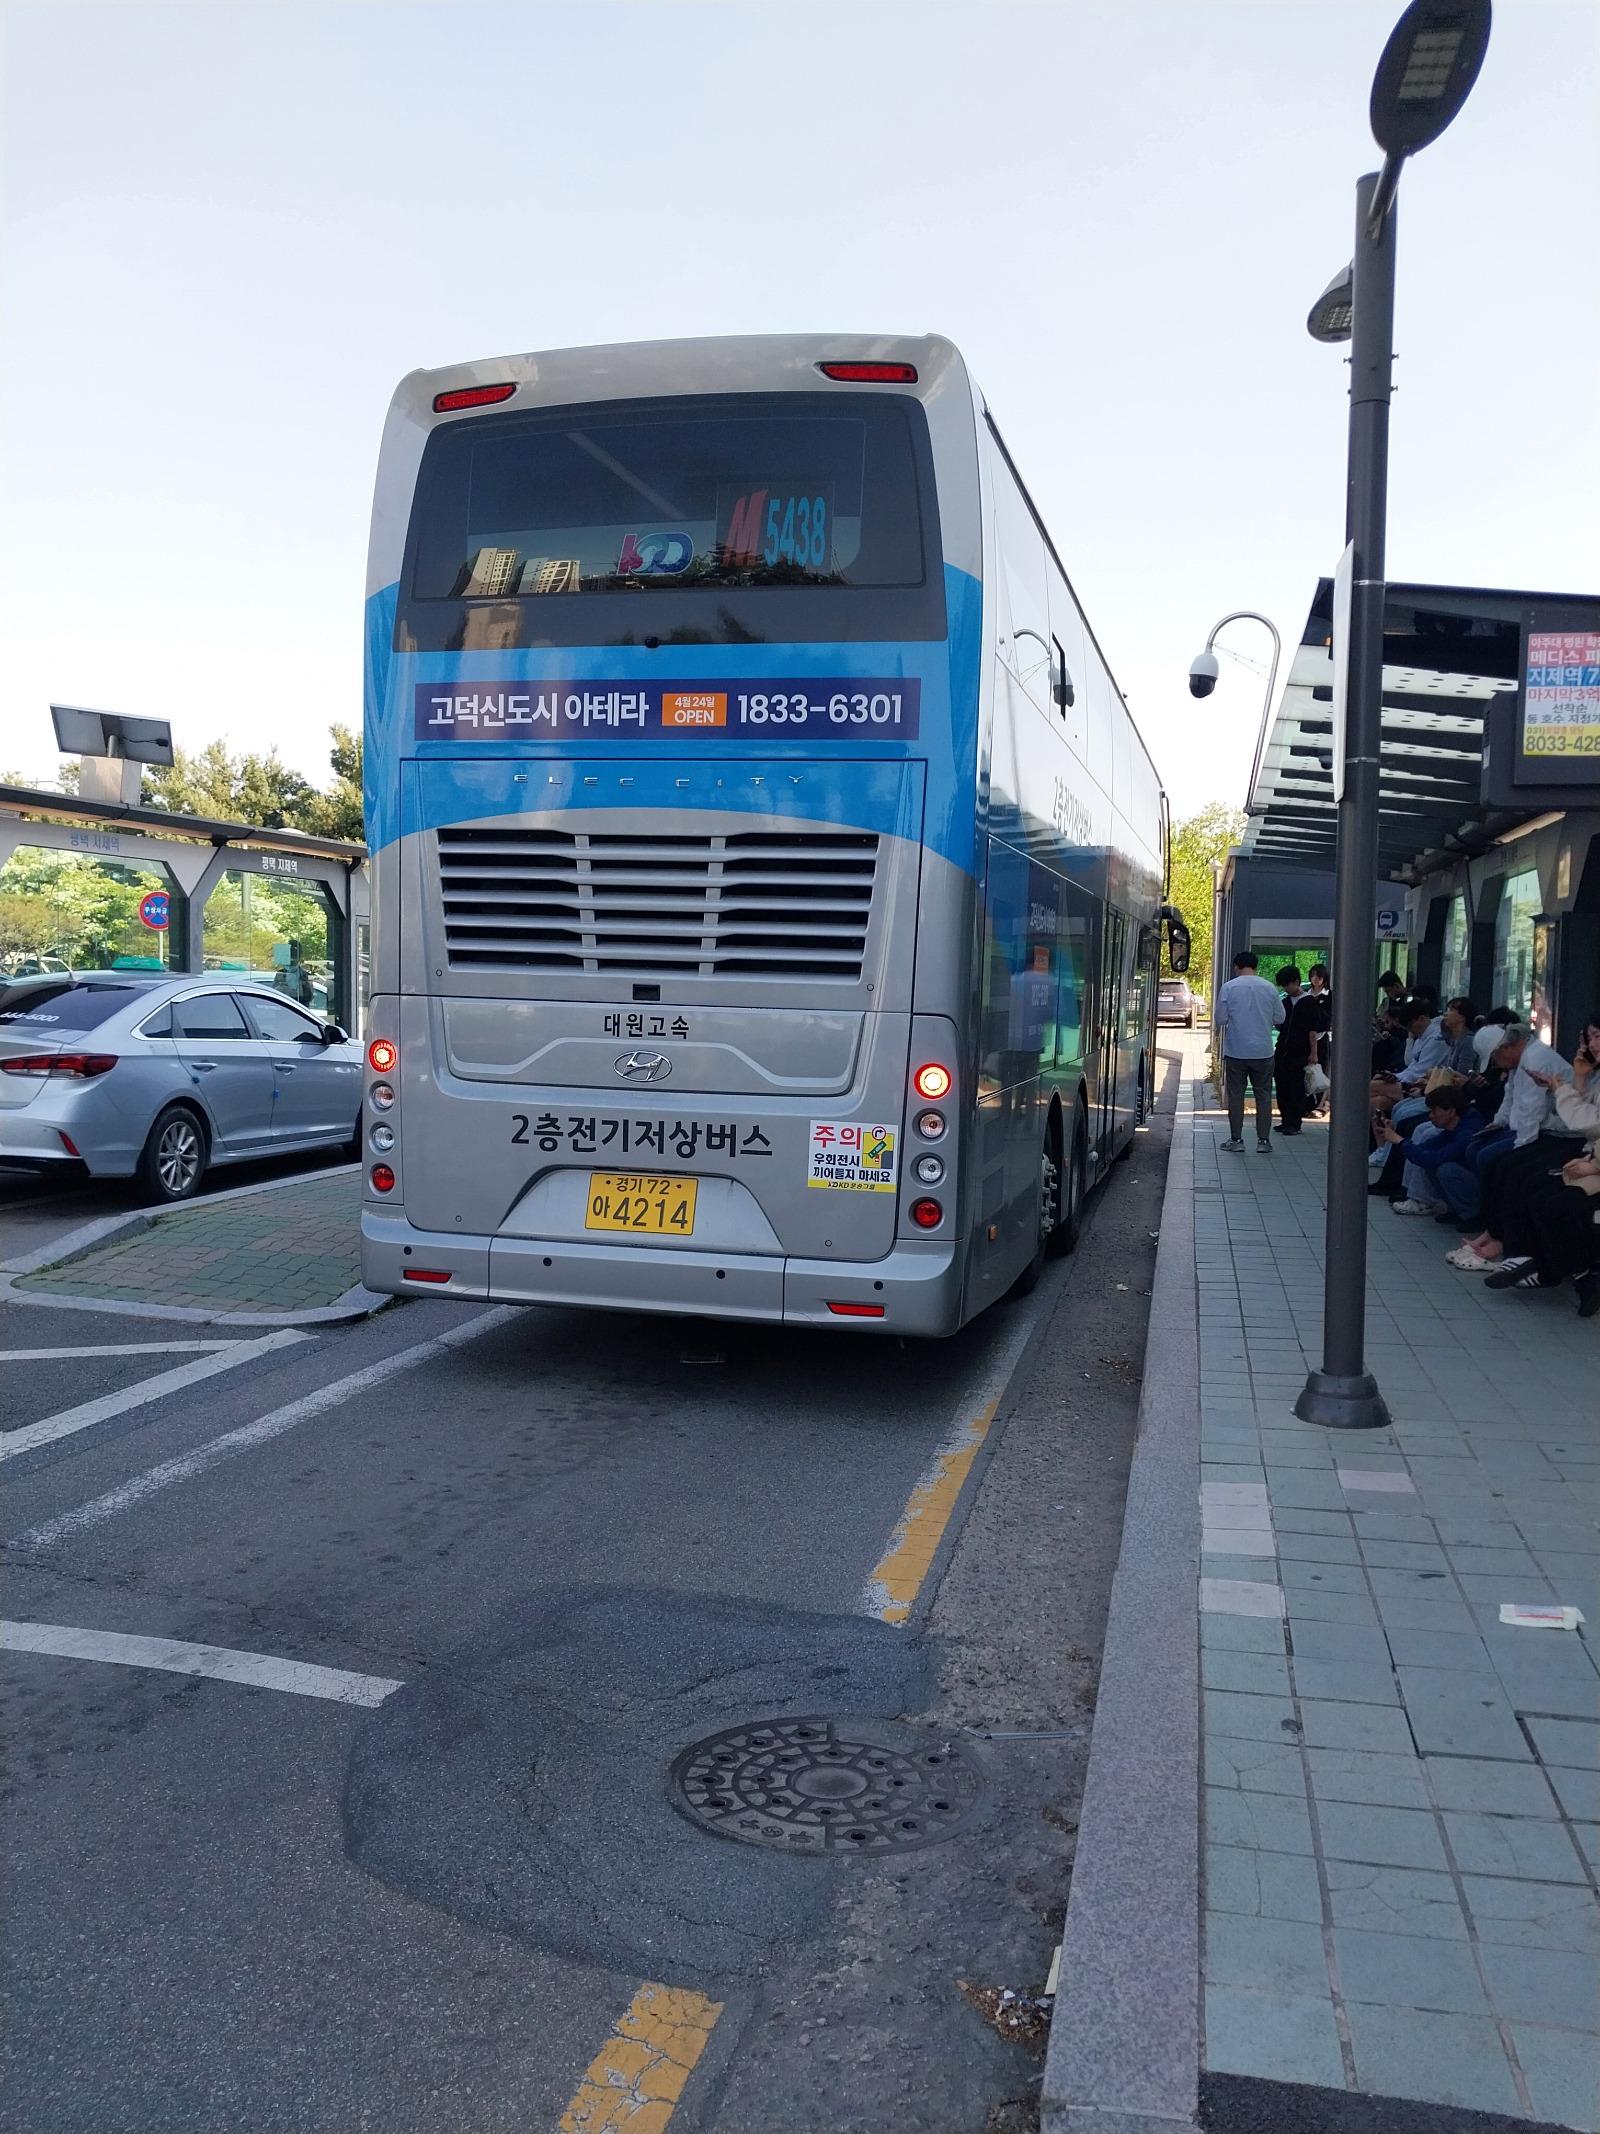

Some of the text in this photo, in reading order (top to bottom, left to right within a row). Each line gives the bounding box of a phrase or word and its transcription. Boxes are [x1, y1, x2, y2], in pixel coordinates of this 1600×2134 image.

[1530, 649, 1580, 665] 메디스
[1529, 666, 1583, 686] 지제역
[428, 691, 650, 727] 고덕신도시 아테라
[674, 696, 715, 708] 4월 24일
[738, 693, 902, 724] 1833-6301
[674, 709, 715, 724] OPEN
[513, 773, 805, 789] ELEC CITY
[69, 831, 90, 848] 평택
[261, 855, 298, 873] 평택 지제역
[604, 1013, 690, 1039] 대원고속
[511, 1112, 773, 1159] 2층전기저상버스
[813, 1125, 862, 1150] 주의
[814, 1153, 860, 1167] 우회전시
[813, 1166, 891, 1182] 끼어들지 마세요
[616, 1177, 671, 1195] 경기 72
